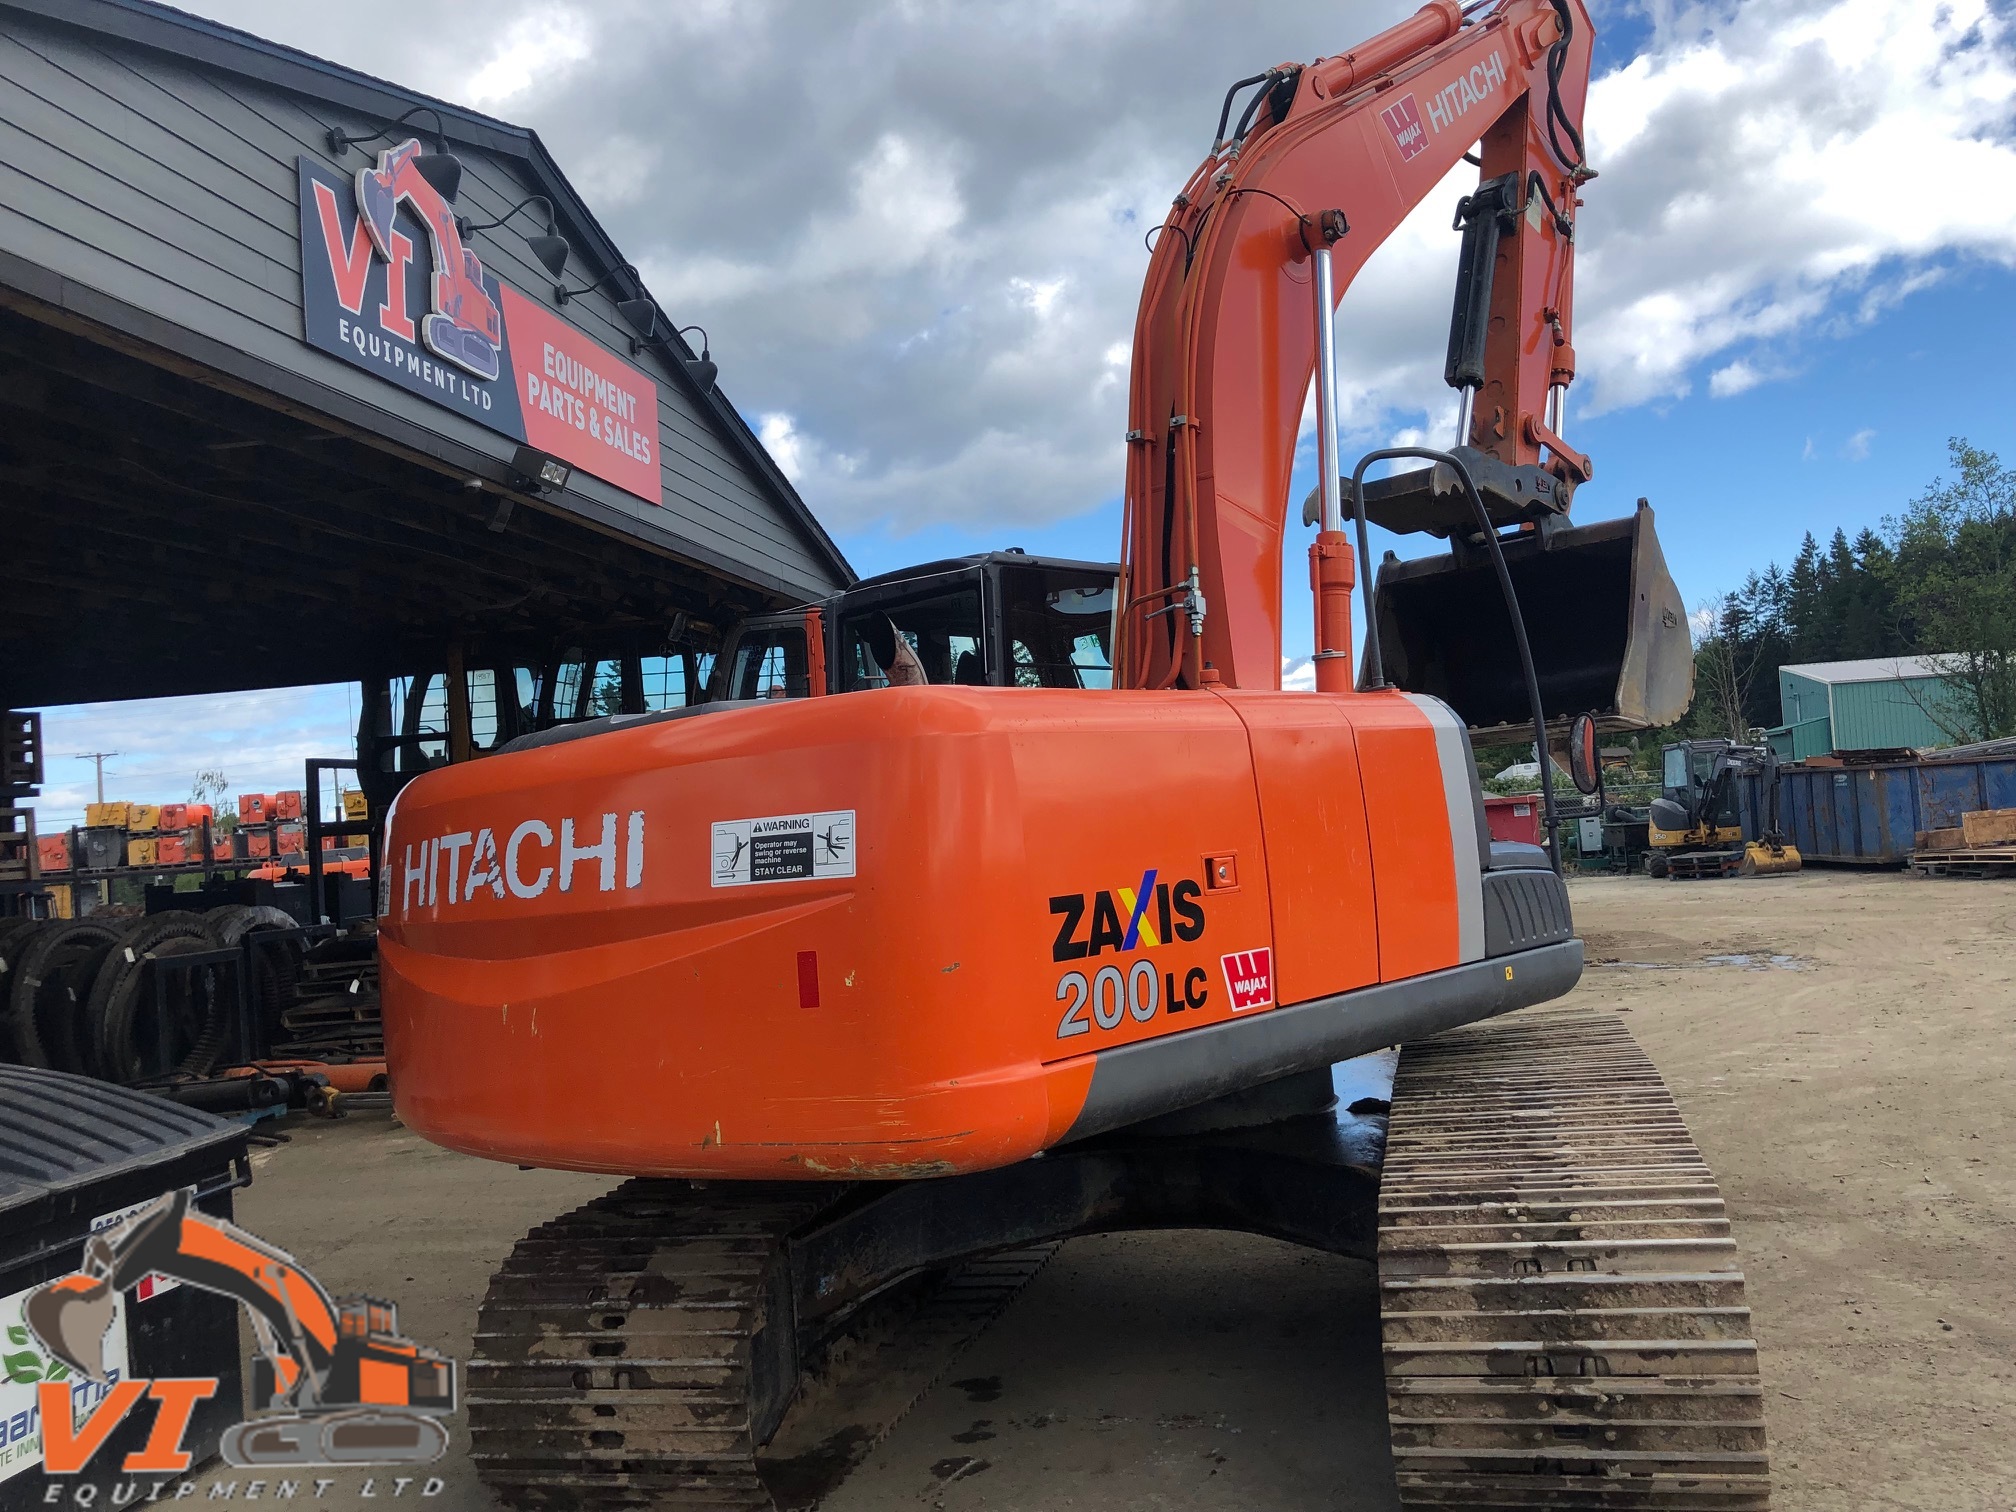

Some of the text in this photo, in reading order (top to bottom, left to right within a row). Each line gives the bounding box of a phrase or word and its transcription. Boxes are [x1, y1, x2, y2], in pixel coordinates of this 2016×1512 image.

[1425, 50, 1507, 134] HITACHI
[1396, 121, 1422, 147] WAJAX
[311, 177, 415, 344] VI
[339, 318, 492, 412] EQUIPMENT LTD
[543, 341, 637, 424] EQUIPMENT
[527, 372, 652, 465] PARTS & SALES
[403, 810, 646, 911] HITACHI
[763, 818, 810, 832] WARNING
[754, 865, 803, 876] STAY CLEAR
[1048, 868, 1206, 963] ZAXIS
[1056, 959, 1208, 1039] 200 LC
[1234, 975, 1268, 996] WAJAX
